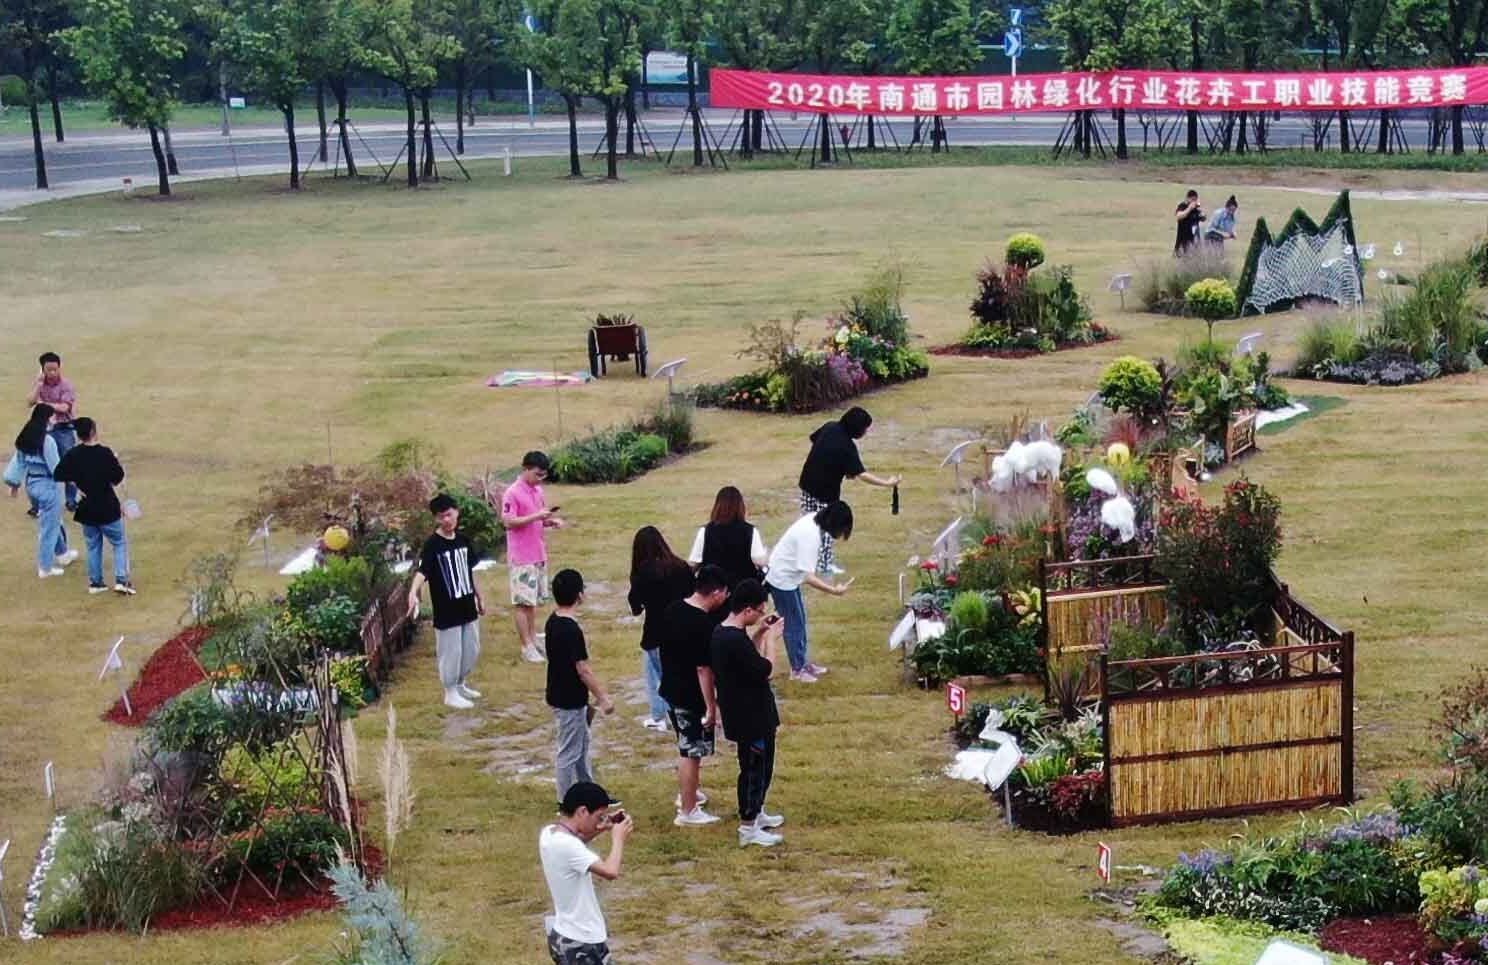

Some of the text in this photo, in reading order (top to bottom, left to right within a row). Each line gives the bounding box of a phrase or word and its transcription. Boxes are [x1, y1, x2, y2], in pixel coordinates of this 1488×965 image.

[767, 73, 1467, 111] 2020年南通市园林绿化行业花卉工职业技能竞赛
[950, 687, 961, 711] 5
[1099, 850, 1107, 877] 4
